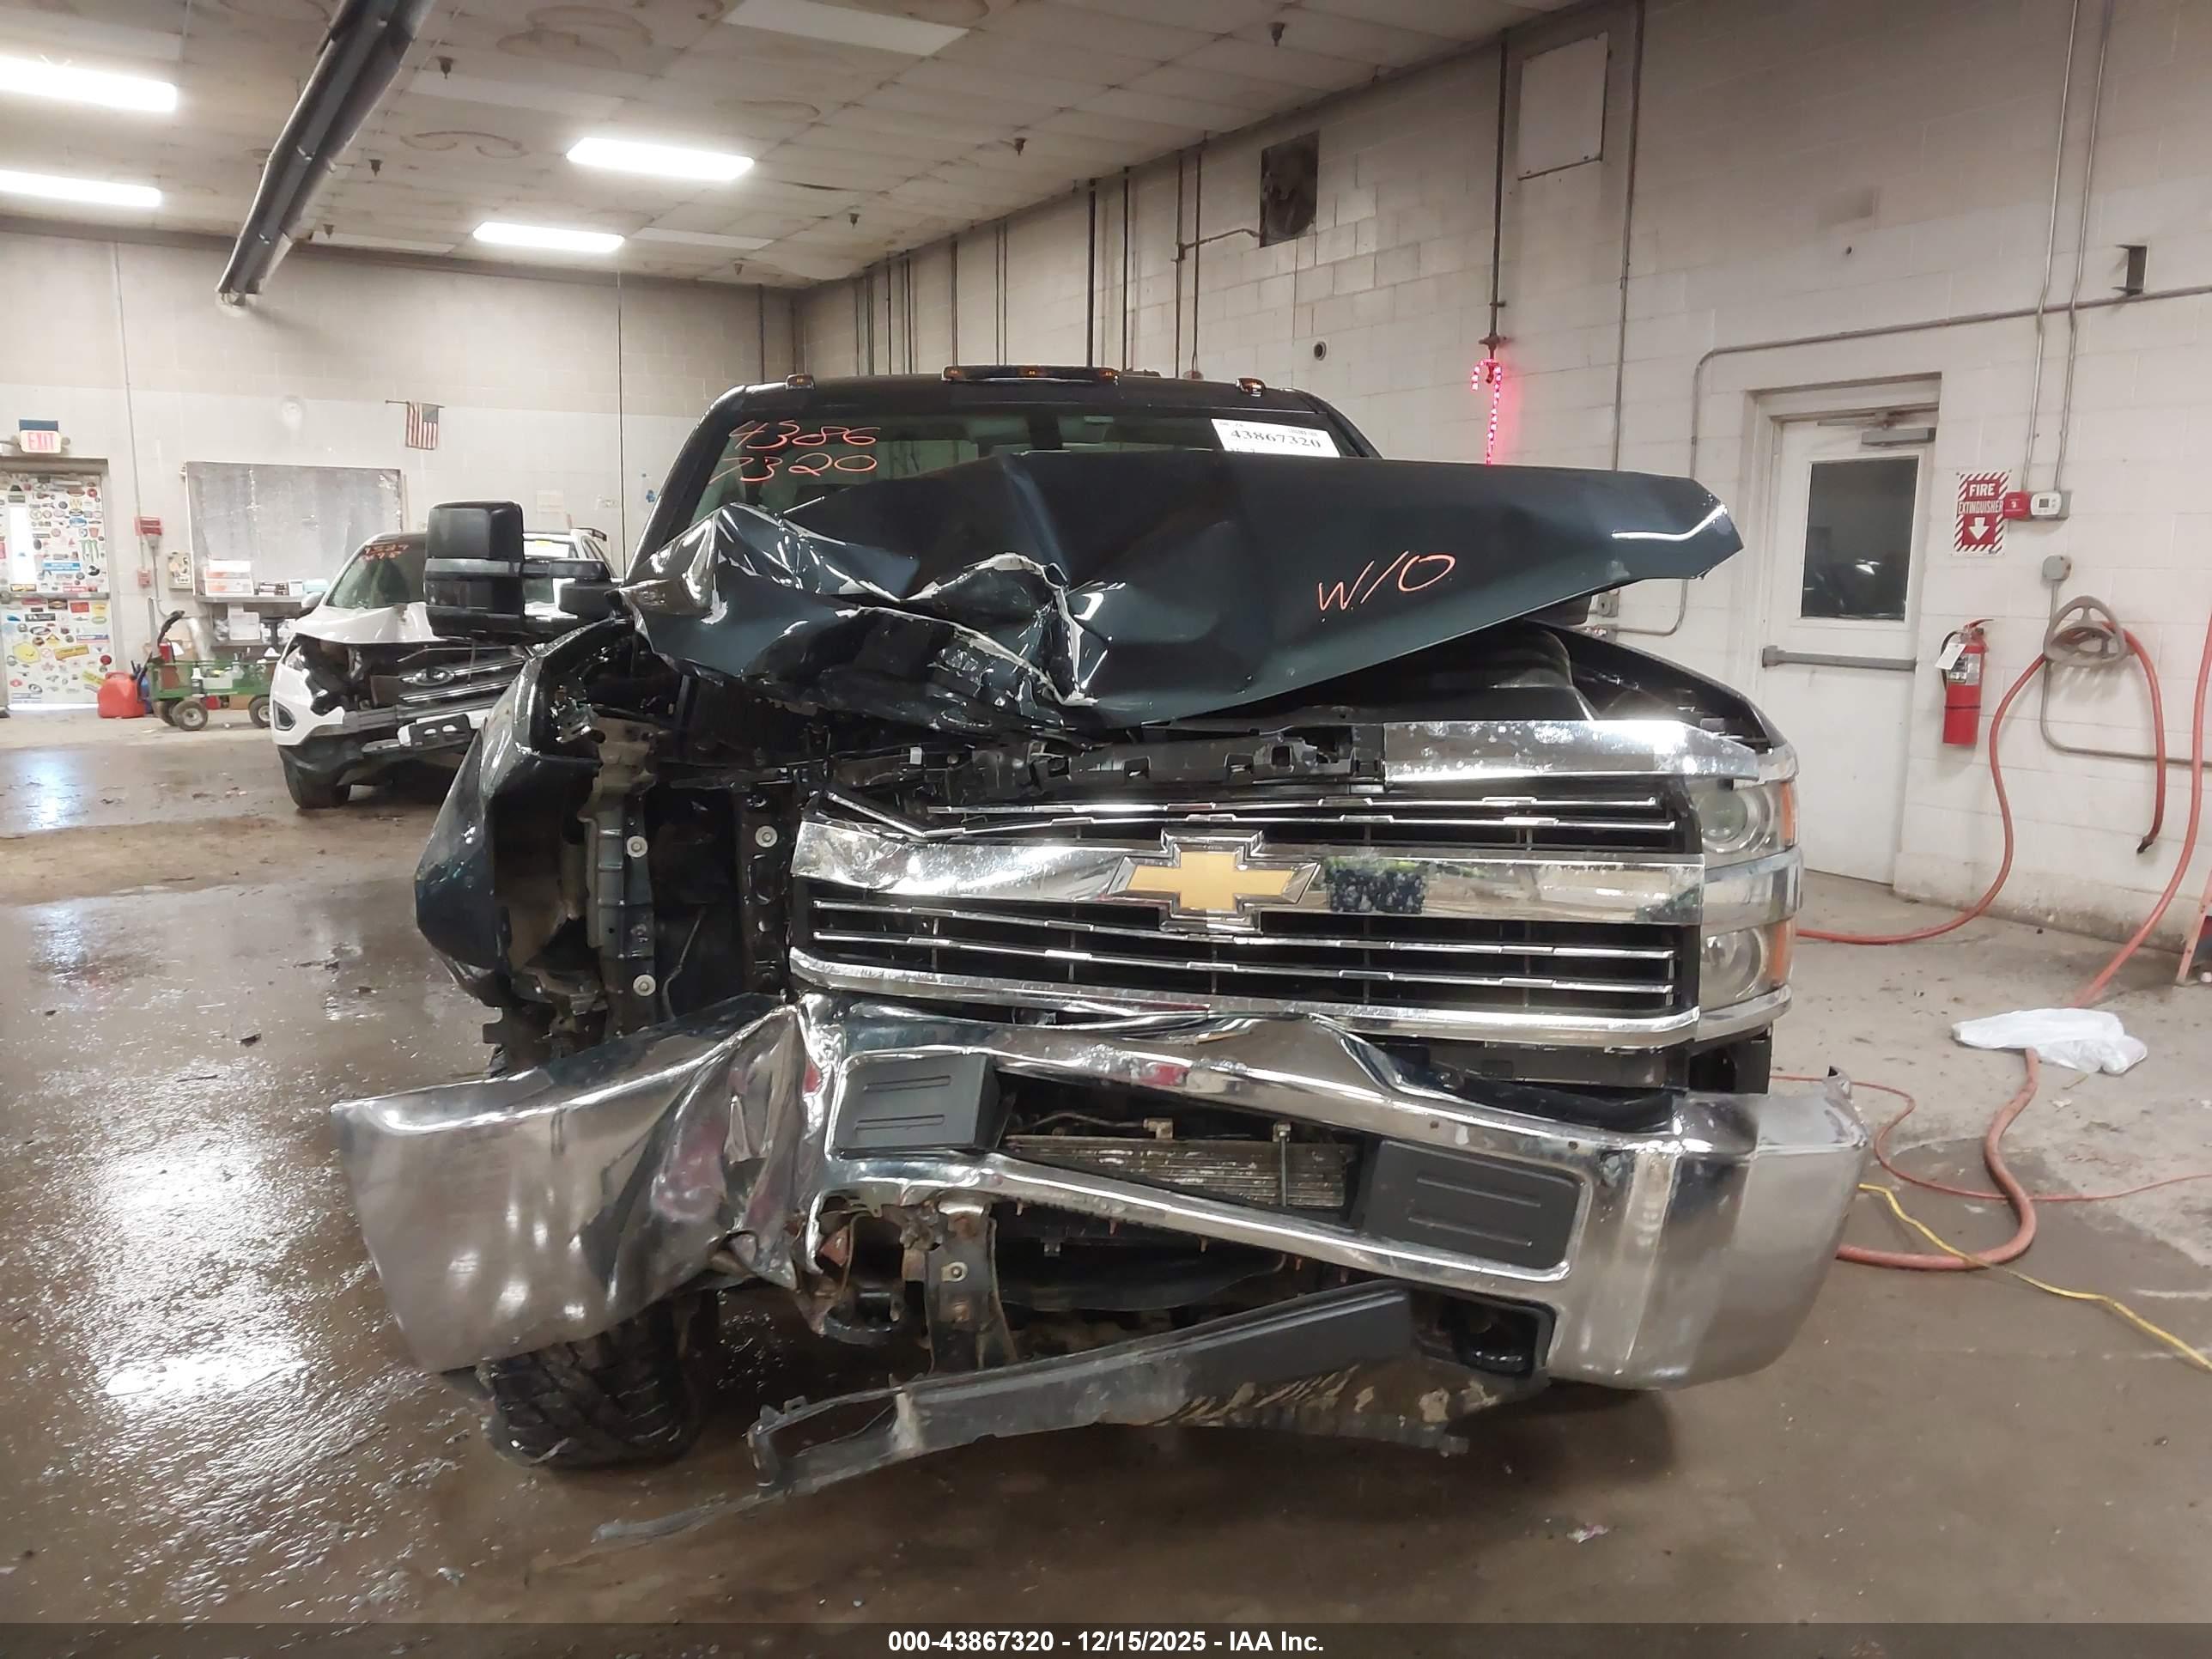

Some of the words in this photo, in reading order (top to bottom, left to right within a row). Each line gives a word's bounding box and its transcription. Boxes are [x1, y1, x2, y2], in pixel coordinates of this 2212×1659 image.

[28, 432, 55, 451] EXIT
[729, 419, 881, 450] 4386
[1231, 429, 1322, 448] 43867320
[708, 453, 878, 484] 7320
[1969, 483, 1996, 497] FIRE
[1958, 500, 2003, 514] EXTINGUISHER
[1318, 550, 1456, 611] W/O
